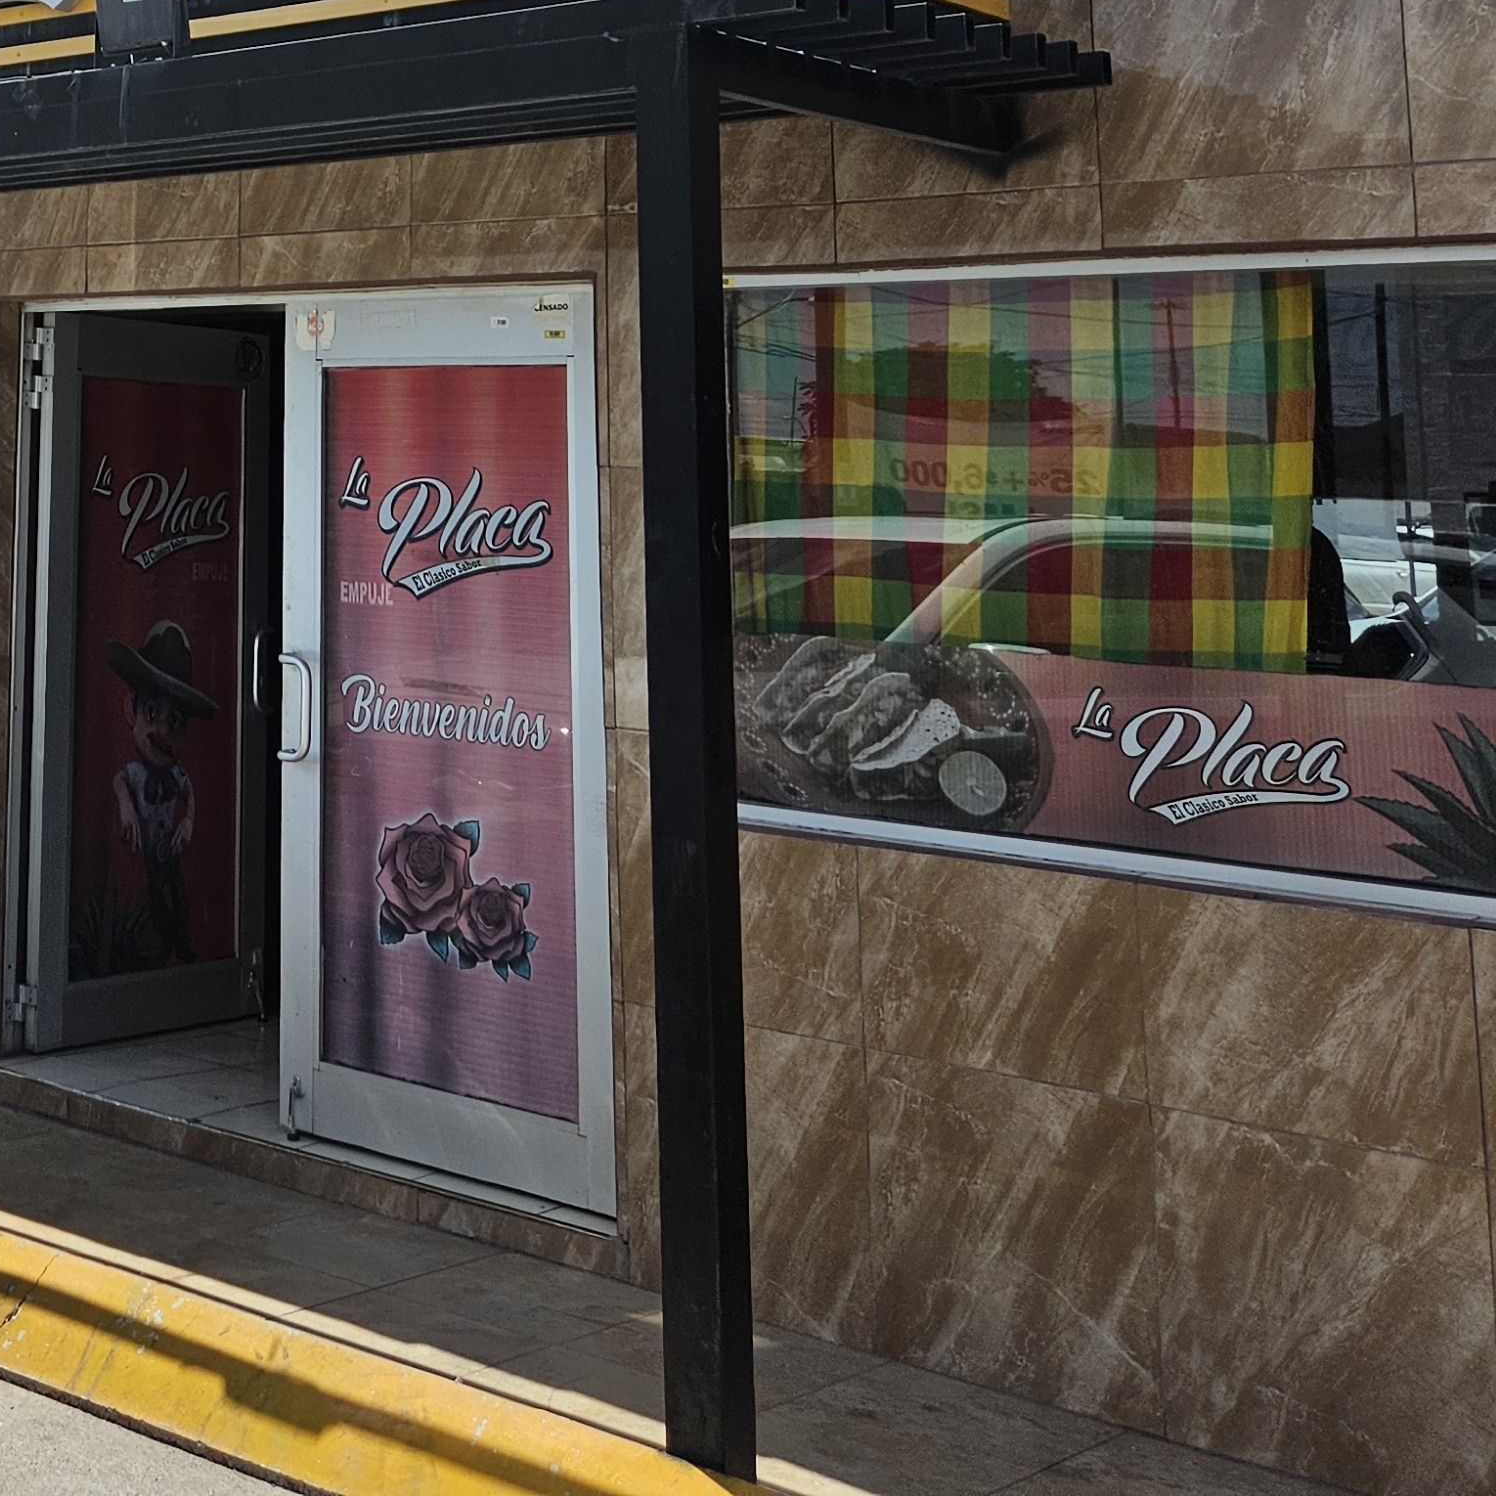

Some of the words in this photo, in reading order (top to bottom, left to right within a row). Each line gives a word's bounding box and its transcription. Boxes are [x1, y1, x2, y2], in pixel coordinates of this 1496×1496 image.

[92, 454, 113, 496] La
[119, 466, 230, 555] Placa
[340, 456, 371, 509] La
[378, 467, 553, 581] Placa
[340, 581, 393, 605] EMPUJE
[412, 571, 425, 592] El
[424, 566, 457, 588] Clasico
[456, 558, 482, 574] Sabor
[341, 674, 551, 750] Bienvenidos
[1072, 686, 1115, 739] La
[1120, 699, 1351, 804] Placa
[1168, 803, 1184, 820] El
[1185, 798, 1226, 816] Clasico
[1226, 793, 1259, 805] Sabor
